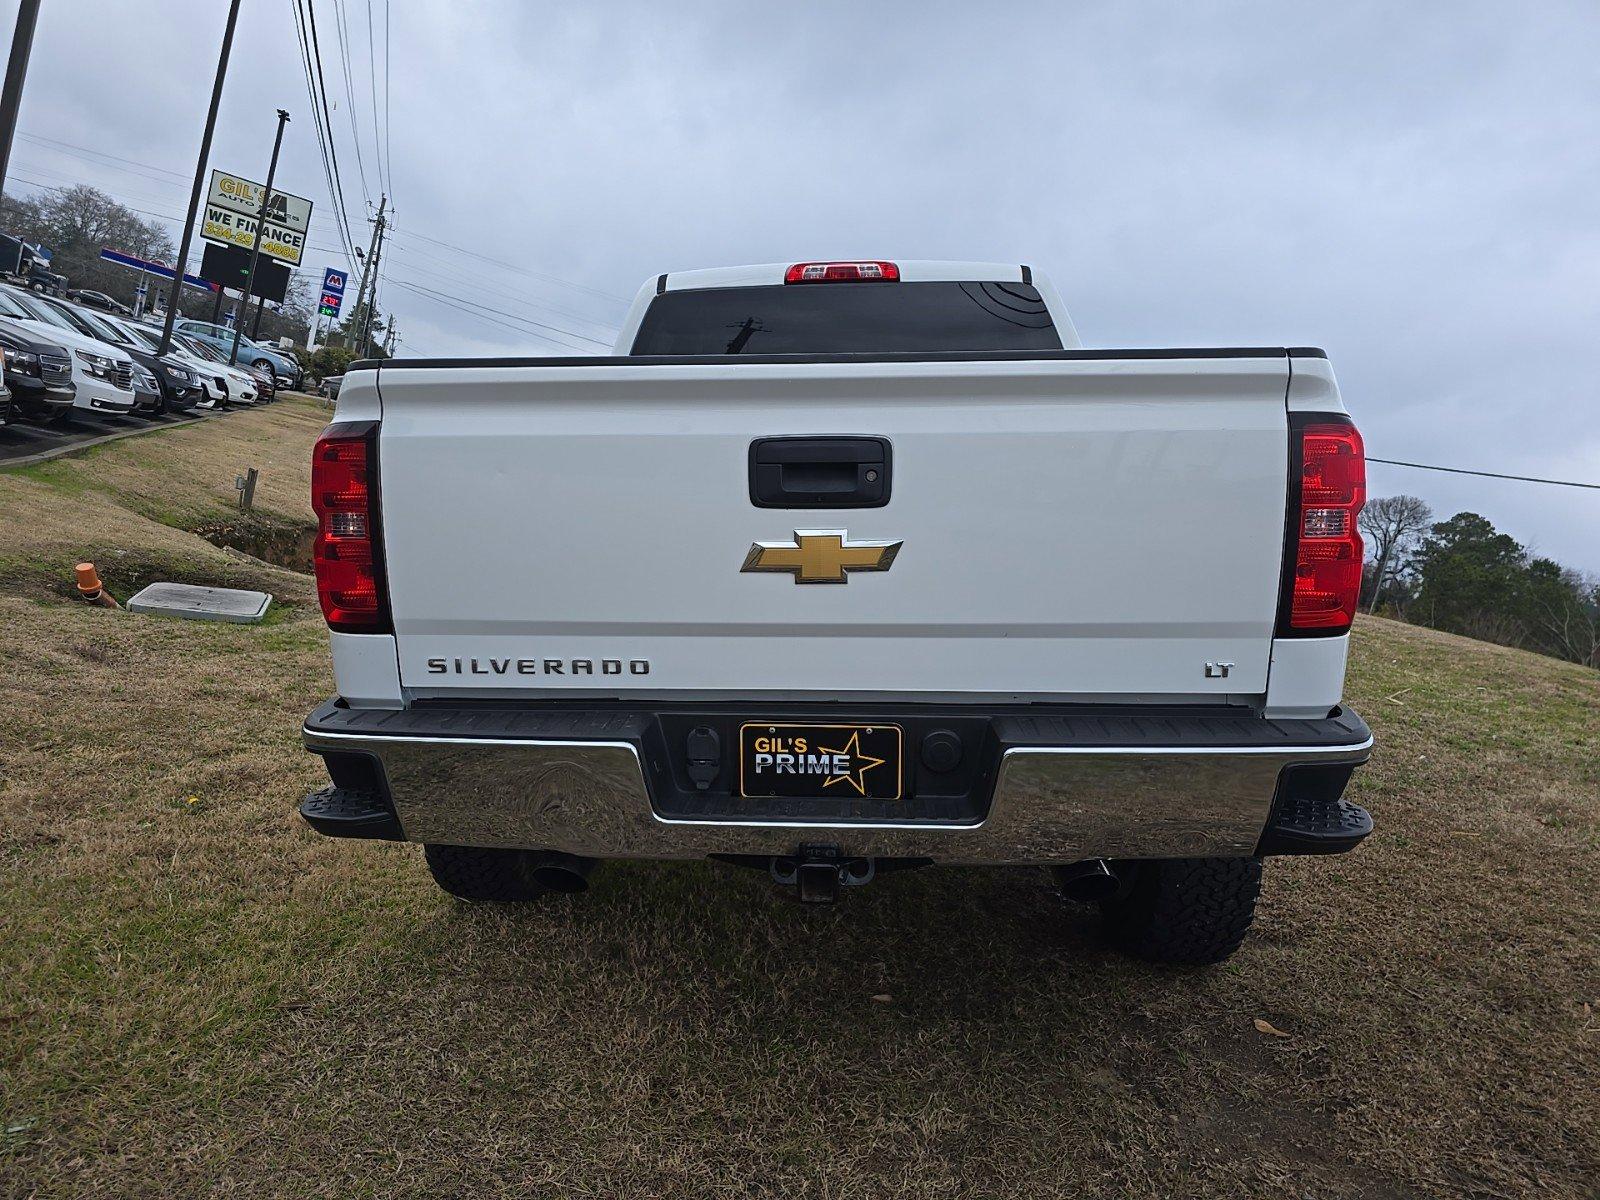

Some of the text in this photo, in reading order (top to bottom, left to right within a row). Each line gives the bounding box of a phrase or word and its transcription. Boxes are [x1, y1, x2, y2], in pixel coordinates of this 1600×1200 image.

[218, 193, 255, 207] AUTO
[209, 209, 302, 248] WE FINANCE
[204, 221, 299, 262] 334-29-4885
[427, 658, 651, 675] SILVERADO
[1205, 662, 1235, 678] LT
[754, 737, 808, 753] GIL'S
[755, 753, 850, 775] PRIME
